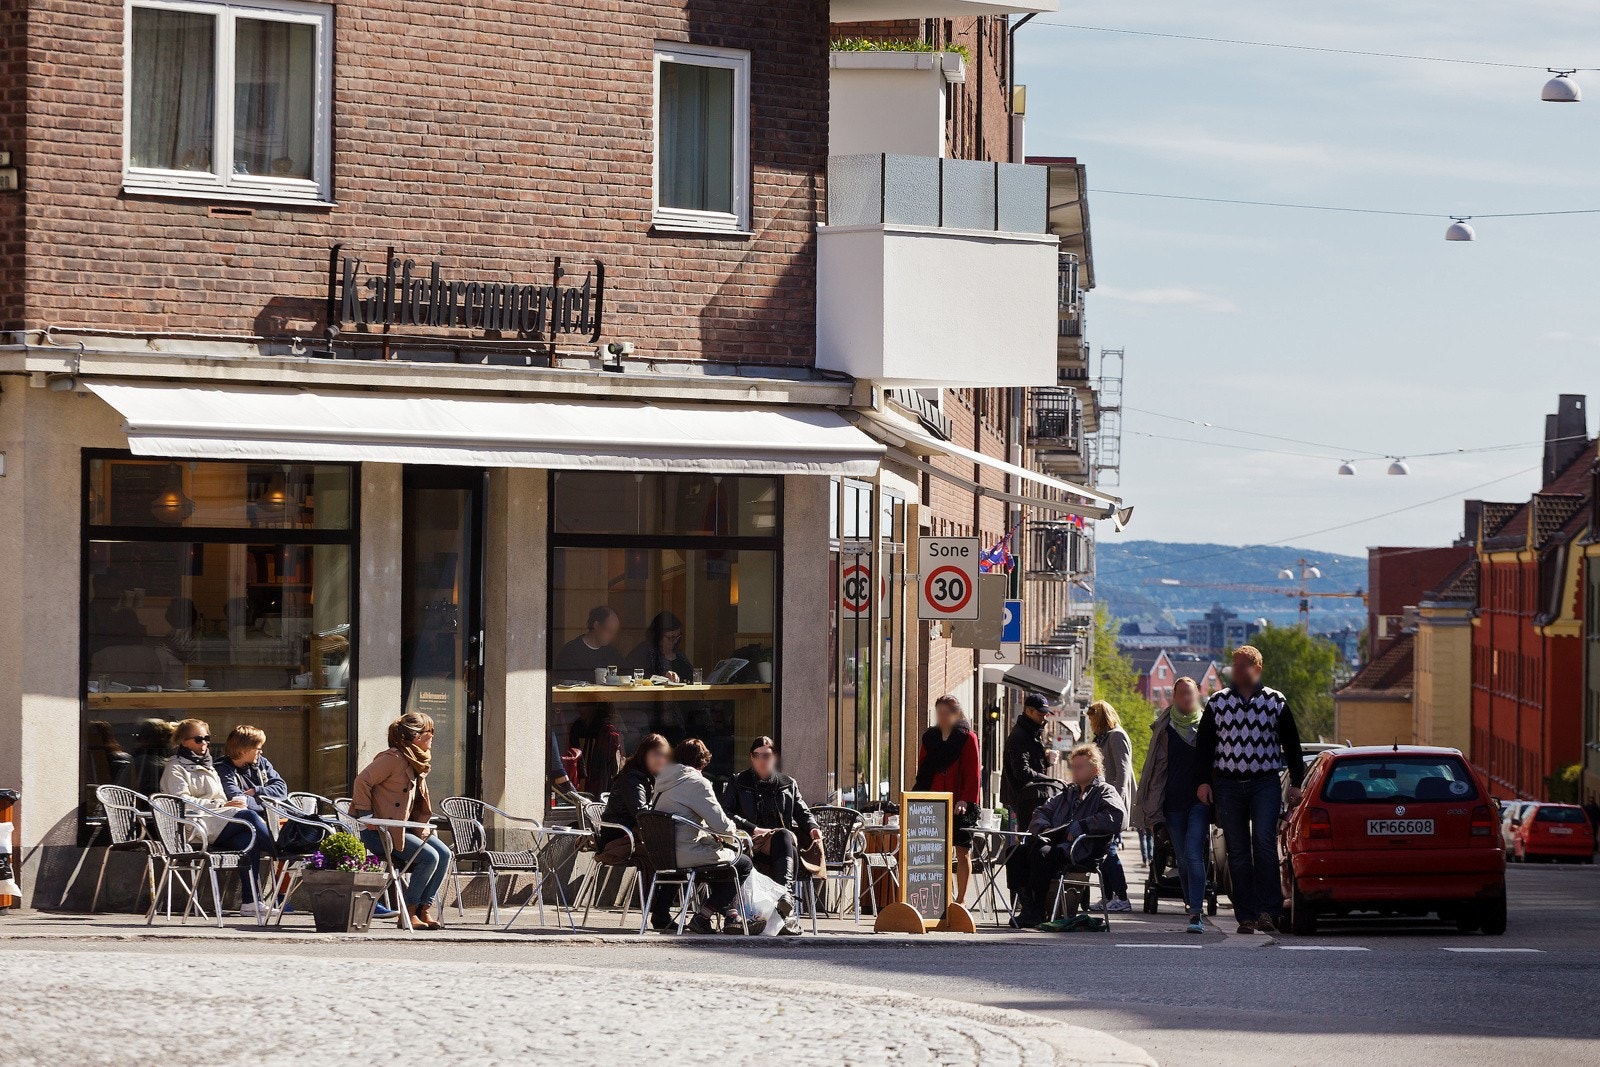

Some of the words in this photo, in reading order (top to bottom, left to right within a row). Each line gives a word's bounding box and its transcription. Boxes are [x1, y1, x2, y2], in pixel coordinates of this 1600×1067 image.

[342, 256, 594, 334] Kaffebrenneriet
[929, 542, 969, 557] Sone
[934, 577, 964, 601] 30
[919, 815, 936, 824] KAFFE
[928, 871, 944, 882] KAFFE
